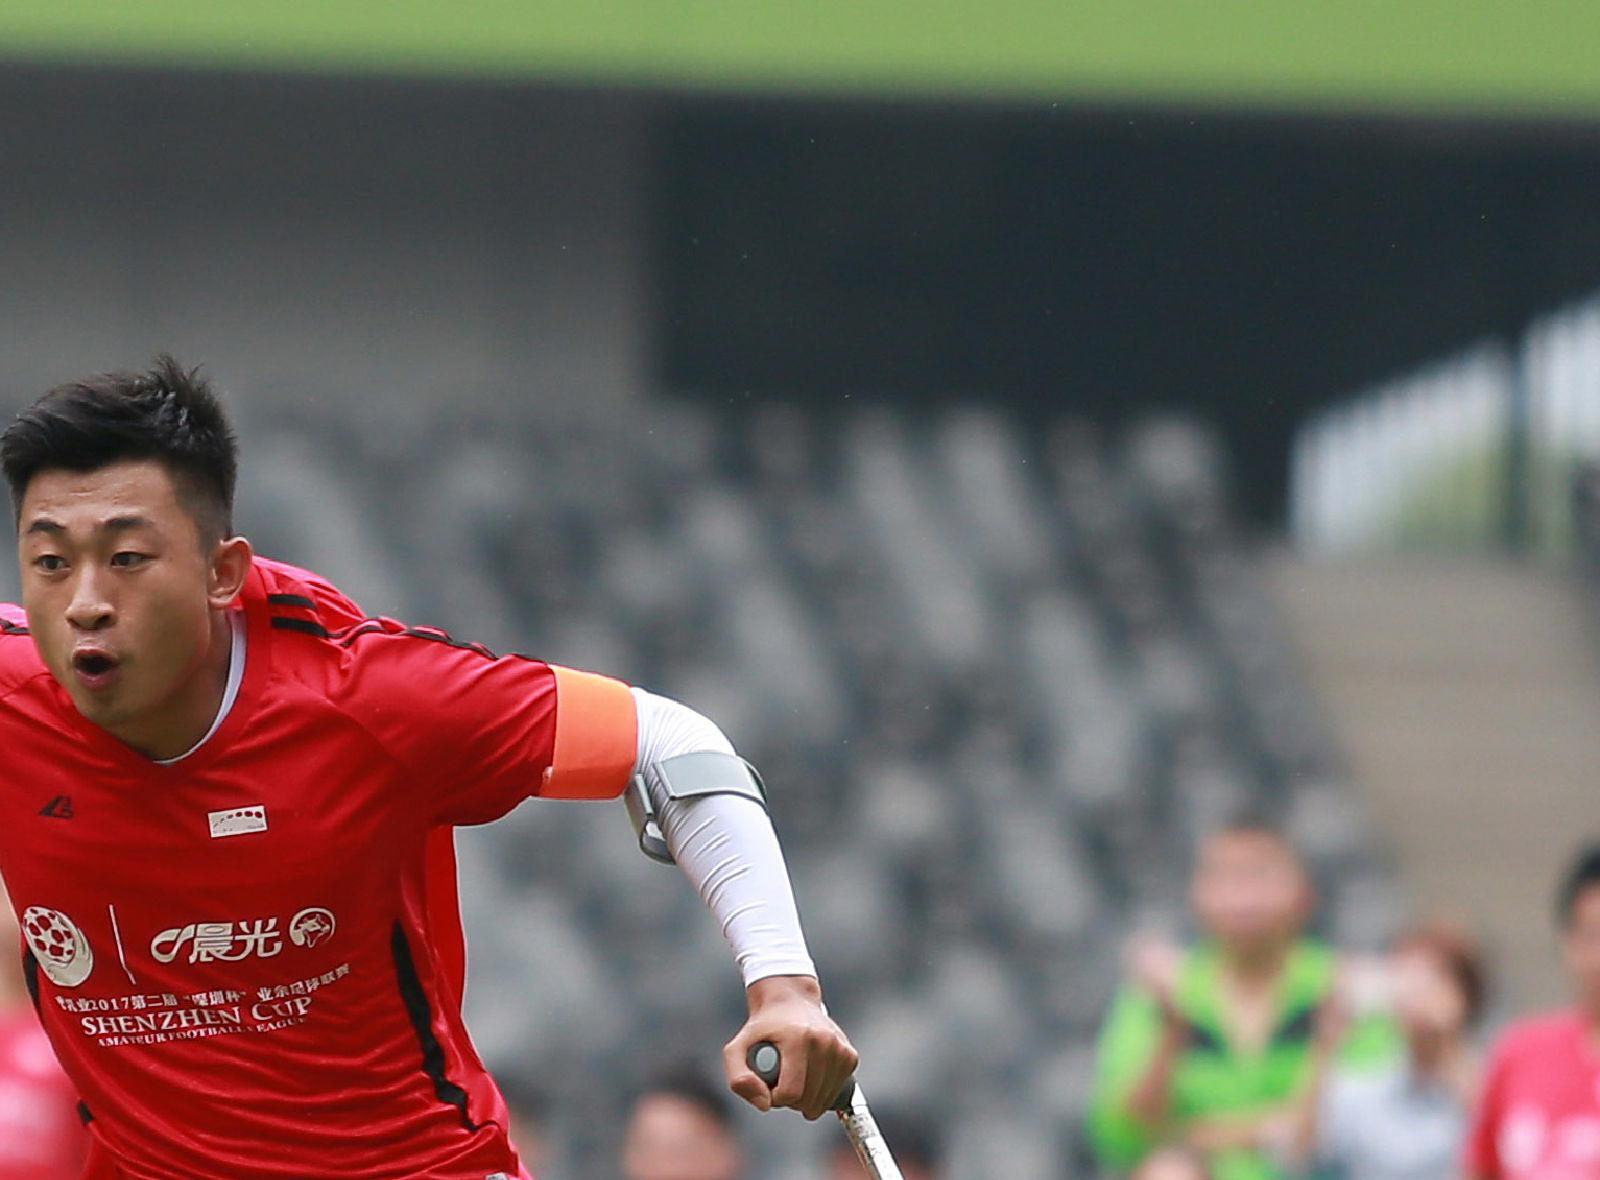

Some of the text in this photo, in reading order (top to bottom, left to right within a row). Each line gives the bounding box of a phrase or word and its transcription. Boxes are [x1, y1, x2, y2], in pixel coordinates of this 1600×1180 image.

[189, 917, 282, 963] 晨光
[81, 997, 312, 1035] SHENZHEN CUP
[99, 1032, 165, 1047] AMATEUR
